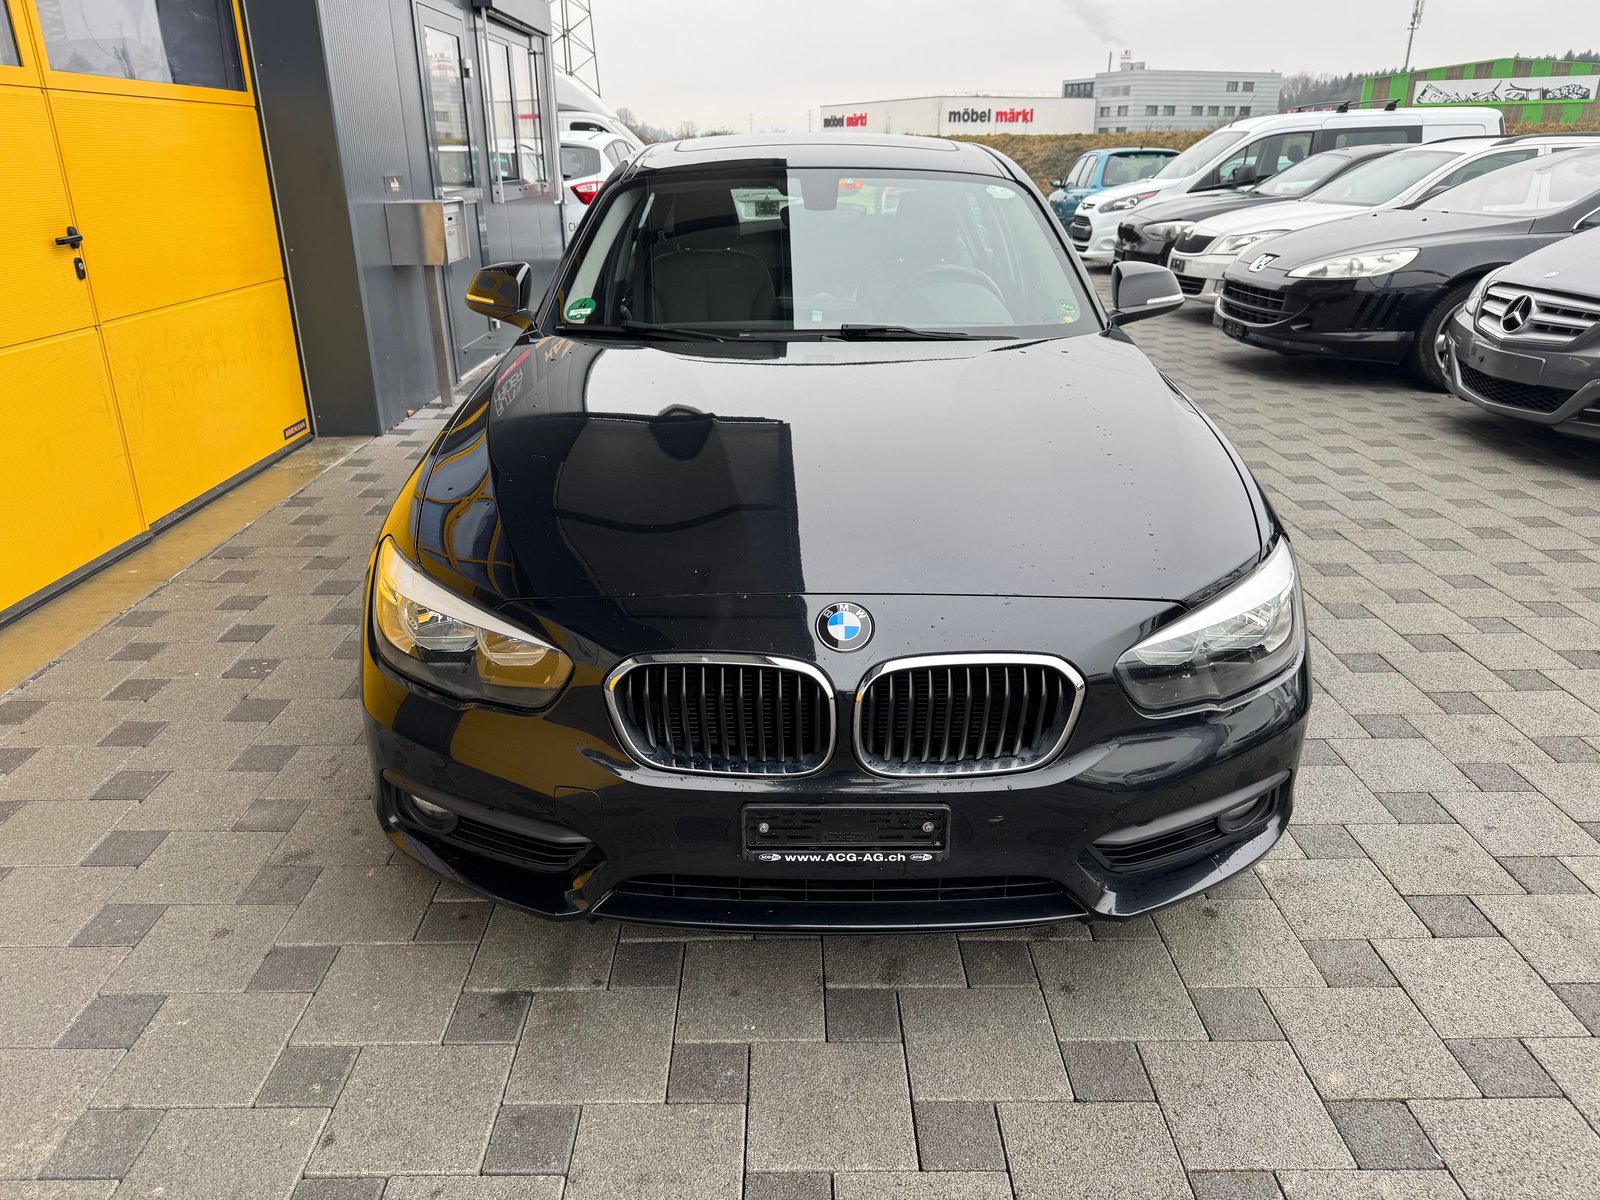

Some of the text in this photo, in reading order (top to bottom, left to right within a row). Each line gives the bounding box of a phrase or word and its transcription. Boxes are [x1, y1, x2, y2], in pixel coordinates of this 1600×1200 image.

[823, 114, 845, 128] möbel
[948, 108, 1034, 123] möbel märki
[578, 298, 587, 309] 4
[823, 602, 867, 619] BMW
[785, 852, 906, 862] www.ACG-AG.ch
